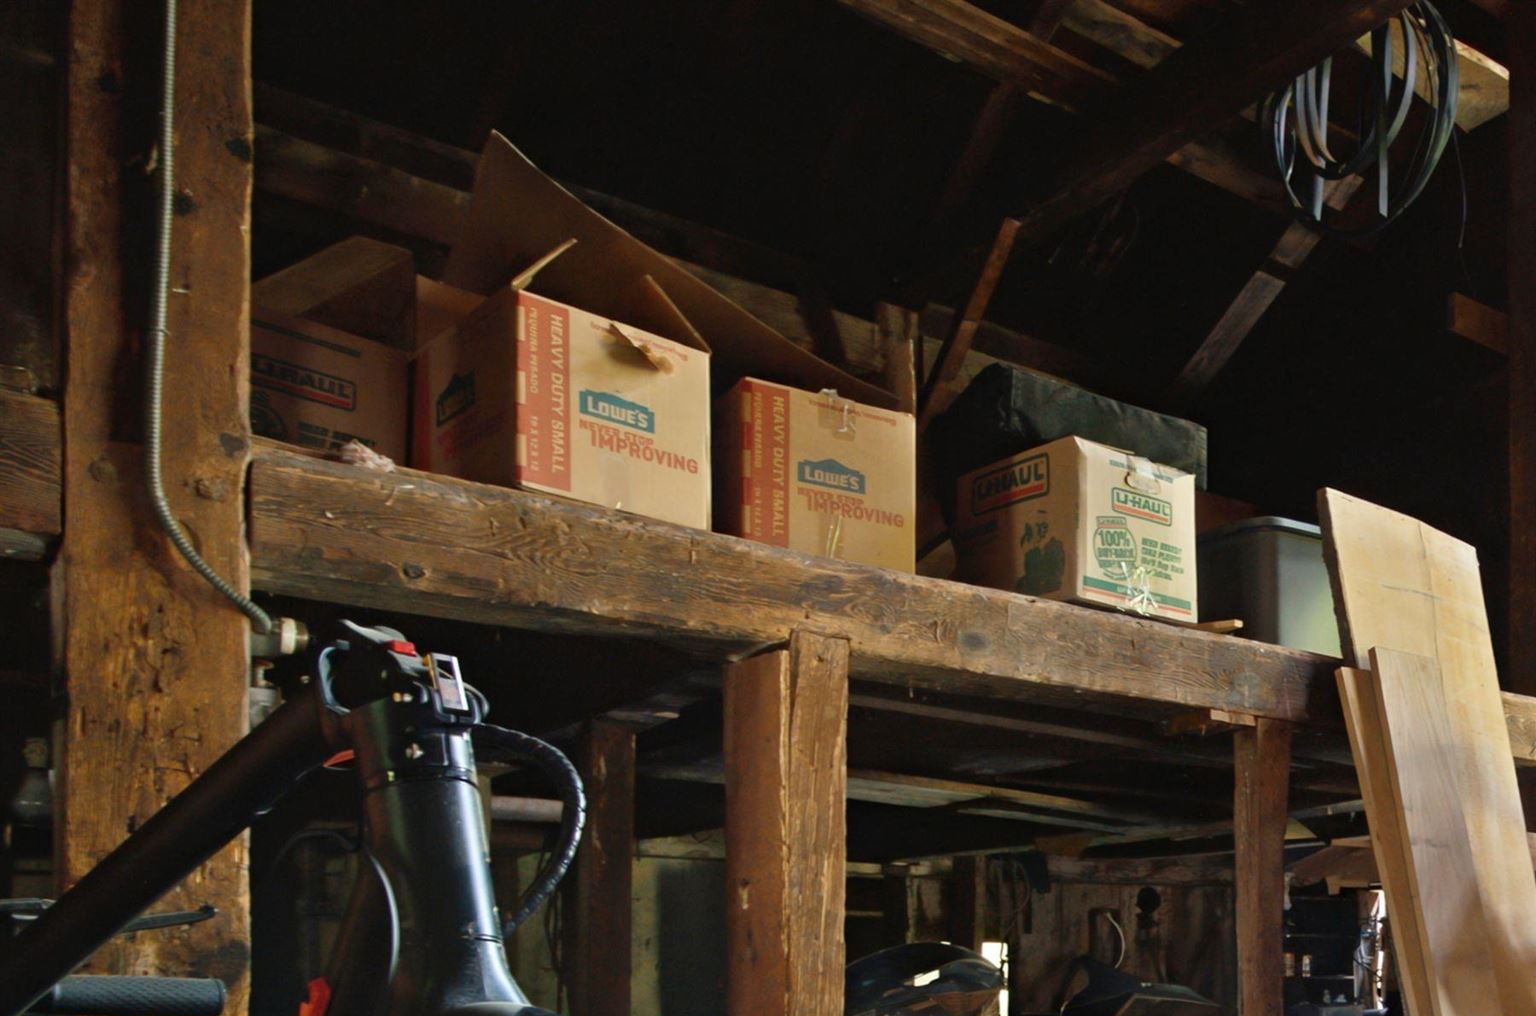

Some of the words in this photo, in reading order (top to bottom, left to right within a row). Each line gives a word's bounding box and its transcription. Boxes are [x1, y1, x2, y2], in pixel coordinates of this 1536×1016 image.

[551, 314, 563, 369] HEAVY
[551, 372, 564, 416] DUTY
[587, 395, 648, 429] LOWE'S
[772, 396, 784, 444] HEAVY
[551, 419, 564, 473] SMALL
[590, 428, 699, 474] IMPROVING
[772, 447, 784, 486] DUTY
[804, 464, 860, 490] LOWE'S
[808, 493, 904, 528] IMPROVING
[1116, 491, 1169, 516] U-HAUL
